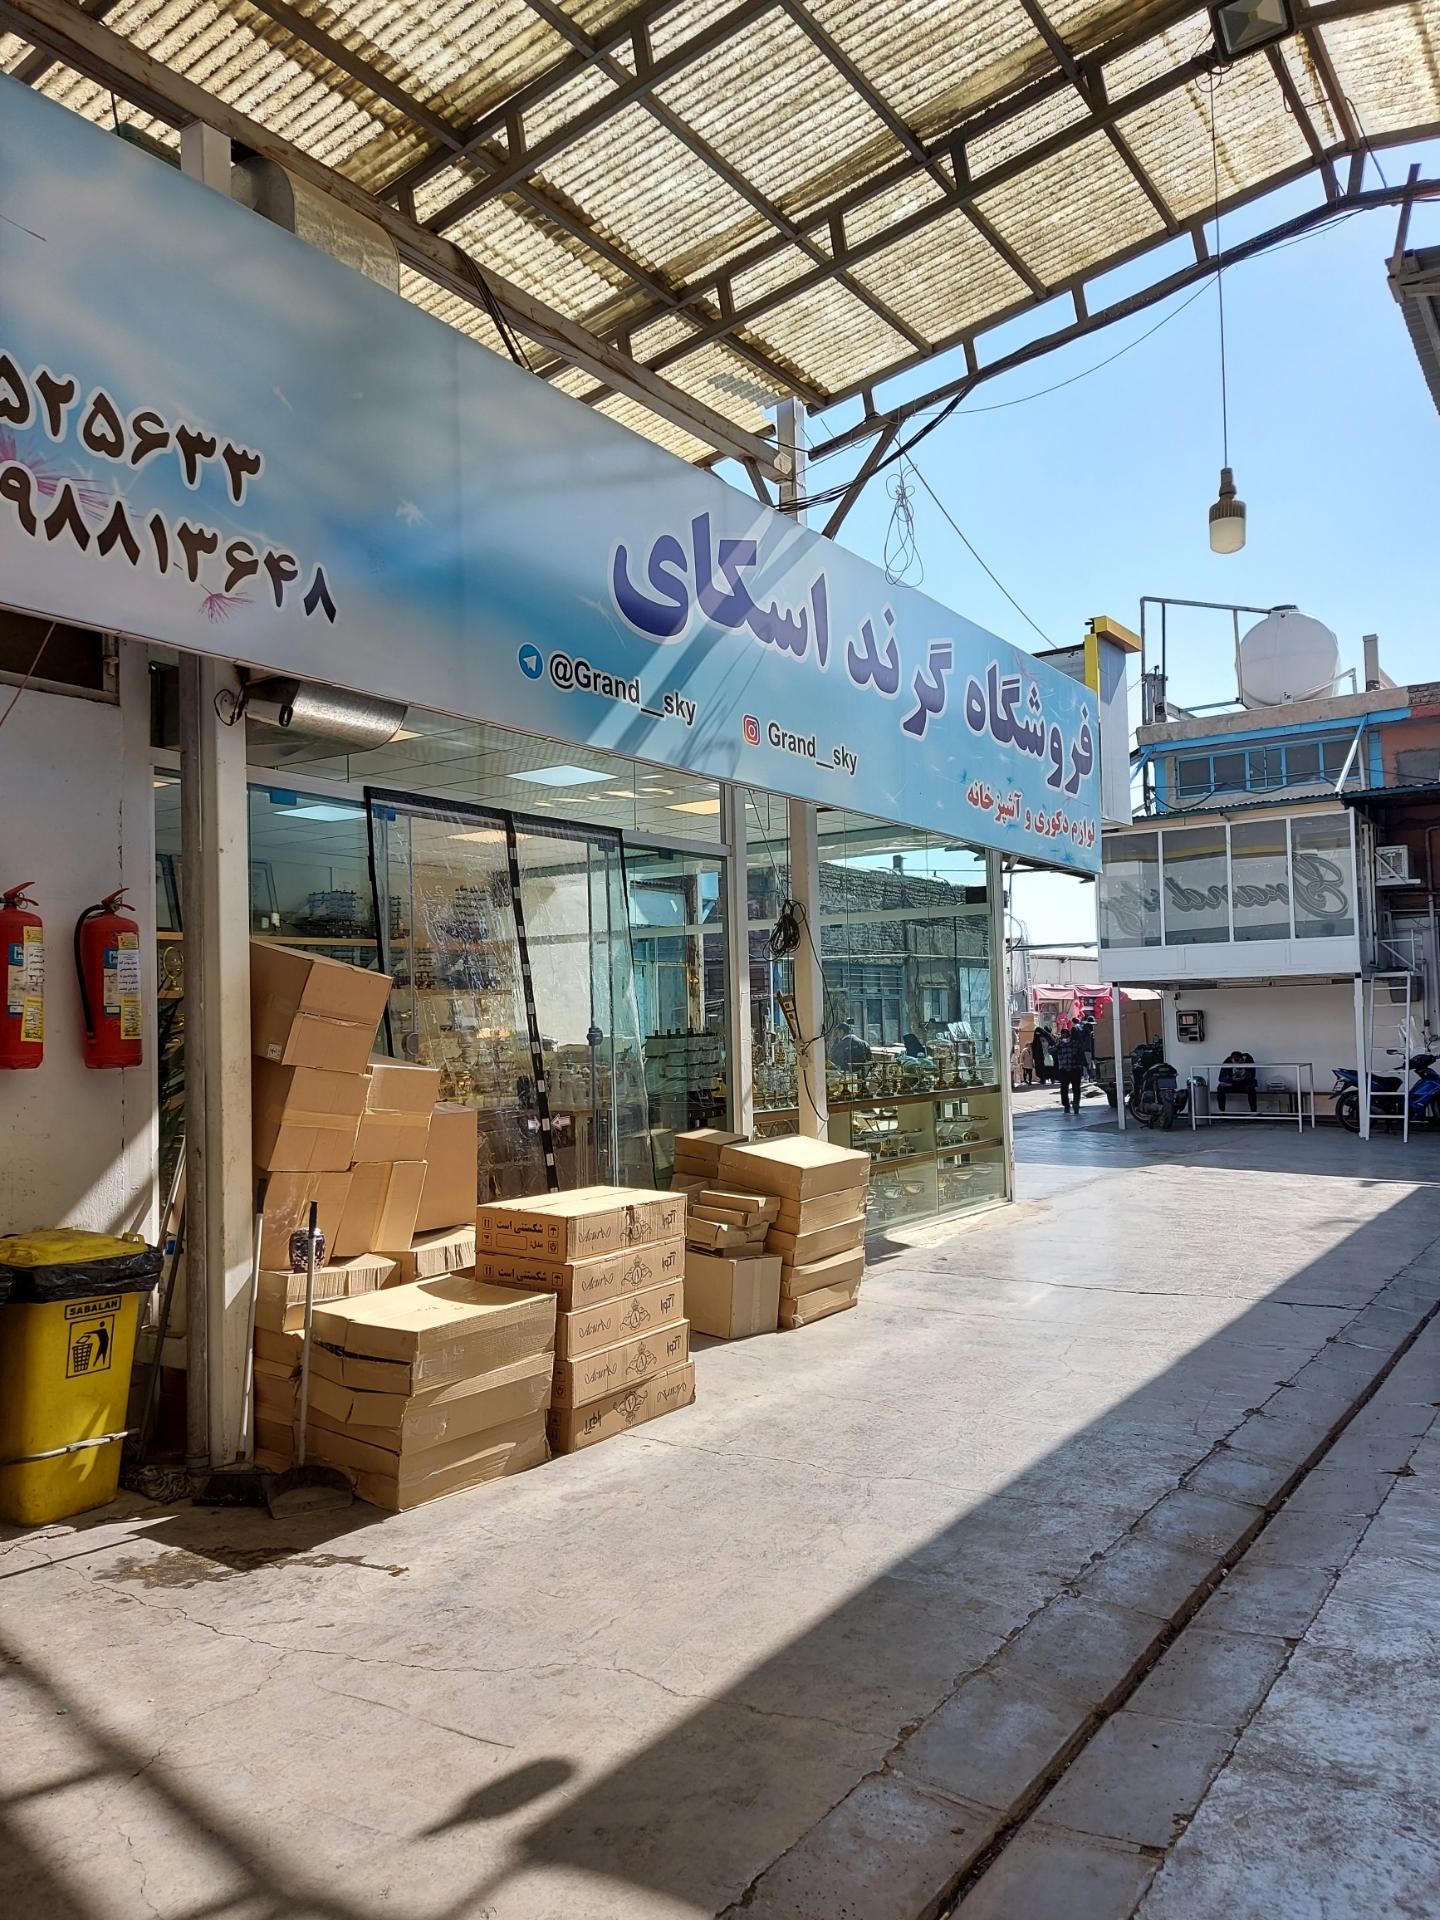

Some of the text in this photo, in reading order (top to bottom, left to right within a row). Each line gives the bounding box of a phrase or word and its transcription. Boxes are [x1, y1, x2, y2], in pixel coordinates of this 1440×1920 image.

[0, 466, 337, 624] ۹۸۸۱۳۶۴۸
[613, 512, 1094, 795] فروشگاه گرند اسکای
[1025, 809, 1031, 830] و
[1034, 810, 1069, 838] دکوری
[1071, 819, 1095, 848] لوازم
[496, 1220, 544, 1234] شکستنی است
[498, 1267, 548, 1282] شکستنی است
[69, 1300, 118, 1316] SABALAN
